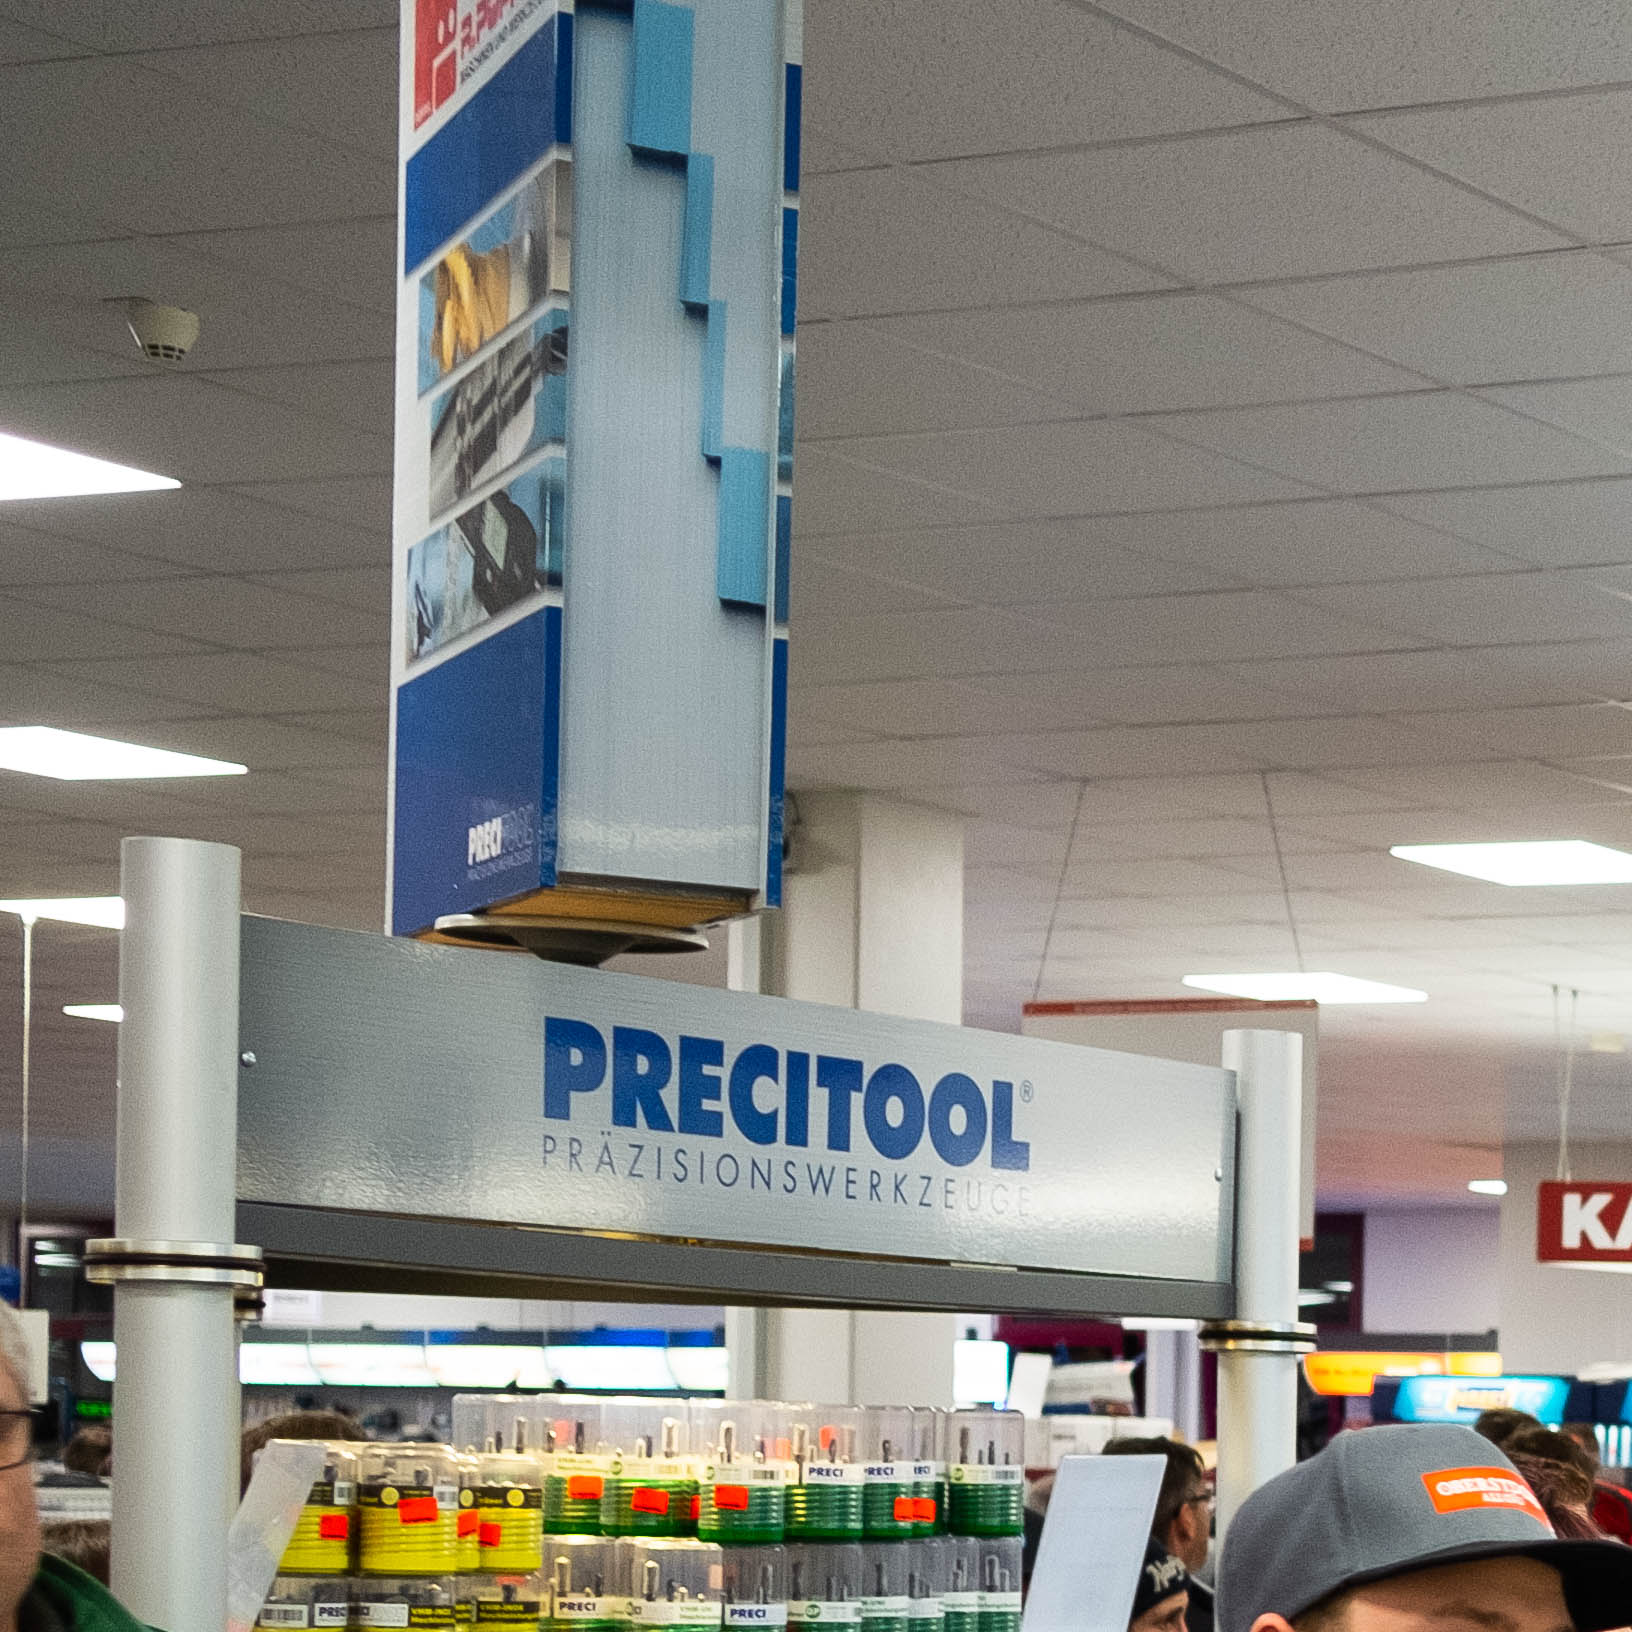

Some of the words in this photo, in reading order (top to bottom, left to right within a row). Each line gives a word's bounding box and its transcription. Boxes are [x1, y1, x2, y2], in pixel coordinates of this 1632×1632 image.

[542, 1131, 1032, 1218] PRÄZISIONSWERKZEUGE
[807, 1466, 844, 1478] PRECI
[558, 1601, 597, 1612] PRECI
[729, 1608, 767, 1619] PRECI
